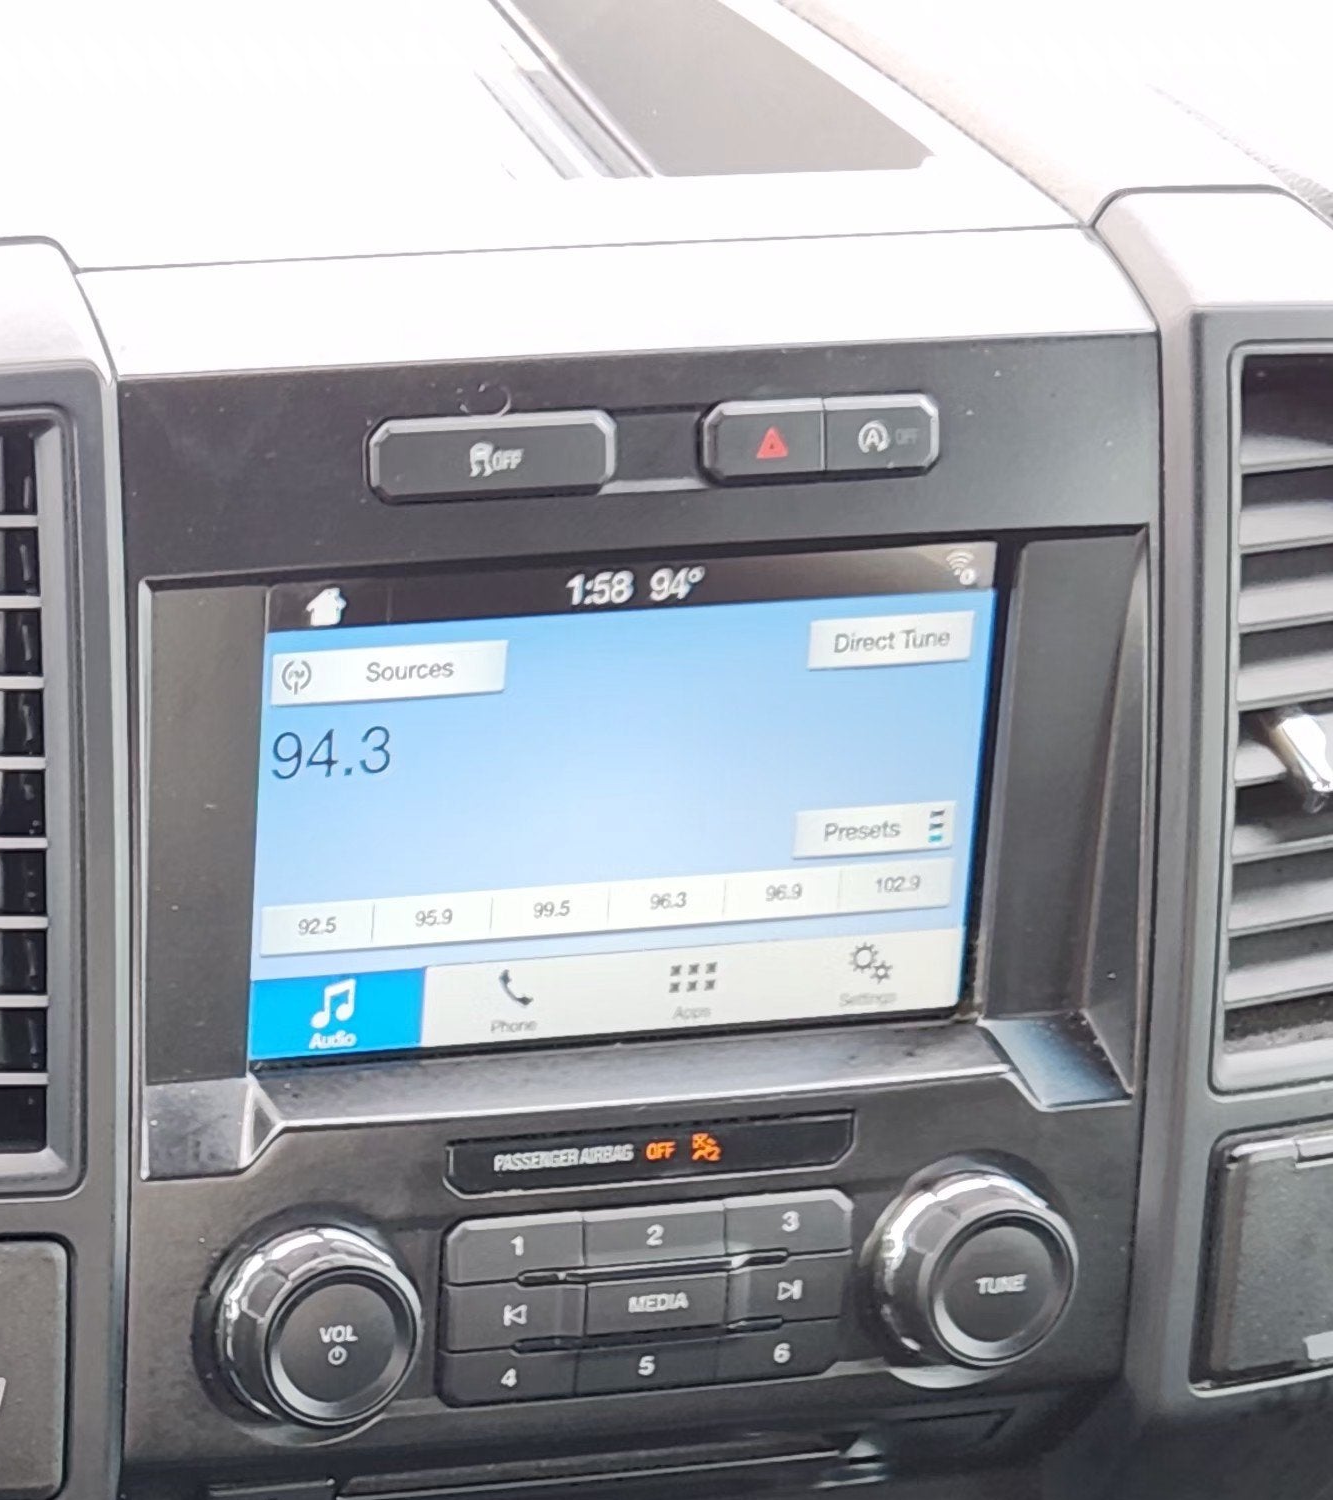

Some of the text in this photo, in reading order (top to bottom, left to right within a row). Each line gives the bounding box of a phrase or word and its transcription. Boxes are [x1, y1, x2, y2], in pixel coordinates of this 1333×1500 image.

[493, 448, 525, 471] OFF
[565, 569, 634, 606] 1:58
[833, 626, 951, 655] Direct Tune
[365, 661, 455, 683] Sources
[271, 725, 391, 780] 94.3
[823, 820, 901, 842] Presets
[297, 916, 337, 937] 92.5
[414, 908, 453, 929] 95.9
[532, 899, 571, 919] 99.5
[649, 891, 688, 910] 96.3
[490, 1018, 537, 1034] Phone
[309, 1030, 357, 1050] Audio
[493, 1139, 676, 1173] PASSENGER AIRBAG OFF
[510, 1210, 800, 1257] 1 2 3
[974, 1273, 1028, 1295] TUNE
[628, 1291, 689, 1313] MEDIA
[319, 1324, 359, 1344] VOL
[500, 1342, 791, 1388] 4 5 6
